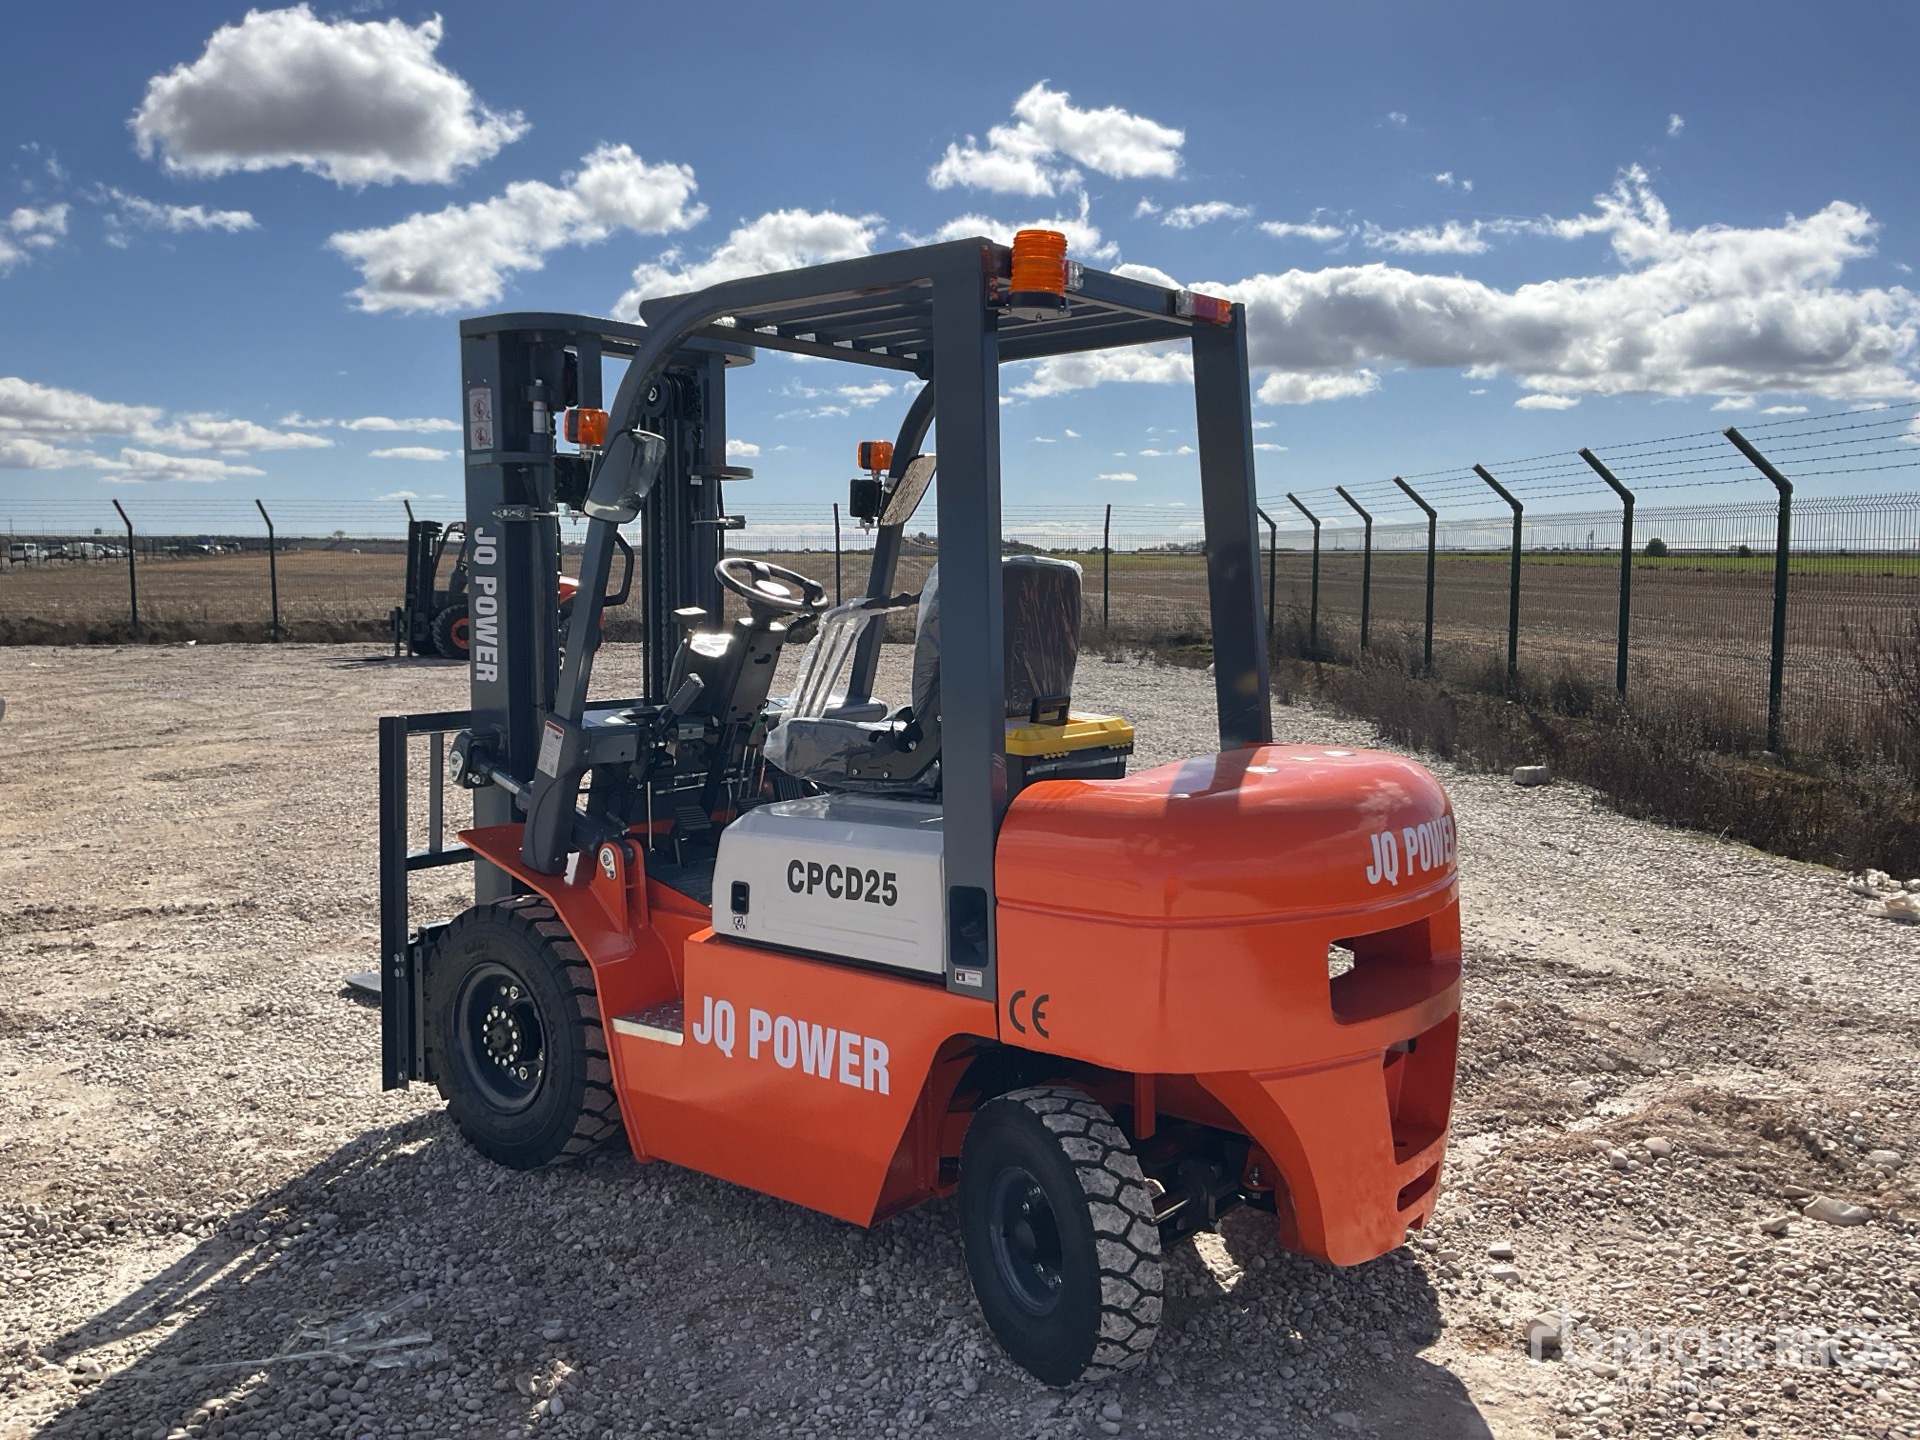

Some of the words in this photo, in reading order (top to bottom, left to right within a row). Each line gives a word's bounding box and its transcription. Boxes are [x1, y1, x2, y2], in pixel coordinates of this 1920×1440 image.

[473, 527, 497, 565] JQ
[475, 576, 498, 682] POWER
[787, 859, 898, 907] CPCD25
[1366, 831, 1399, 886] JQ
[1008, 989, 1049, 1039] CE
[693, 996, 735, 1058] JQ
[749, 1008, 889, 1095] POWER
